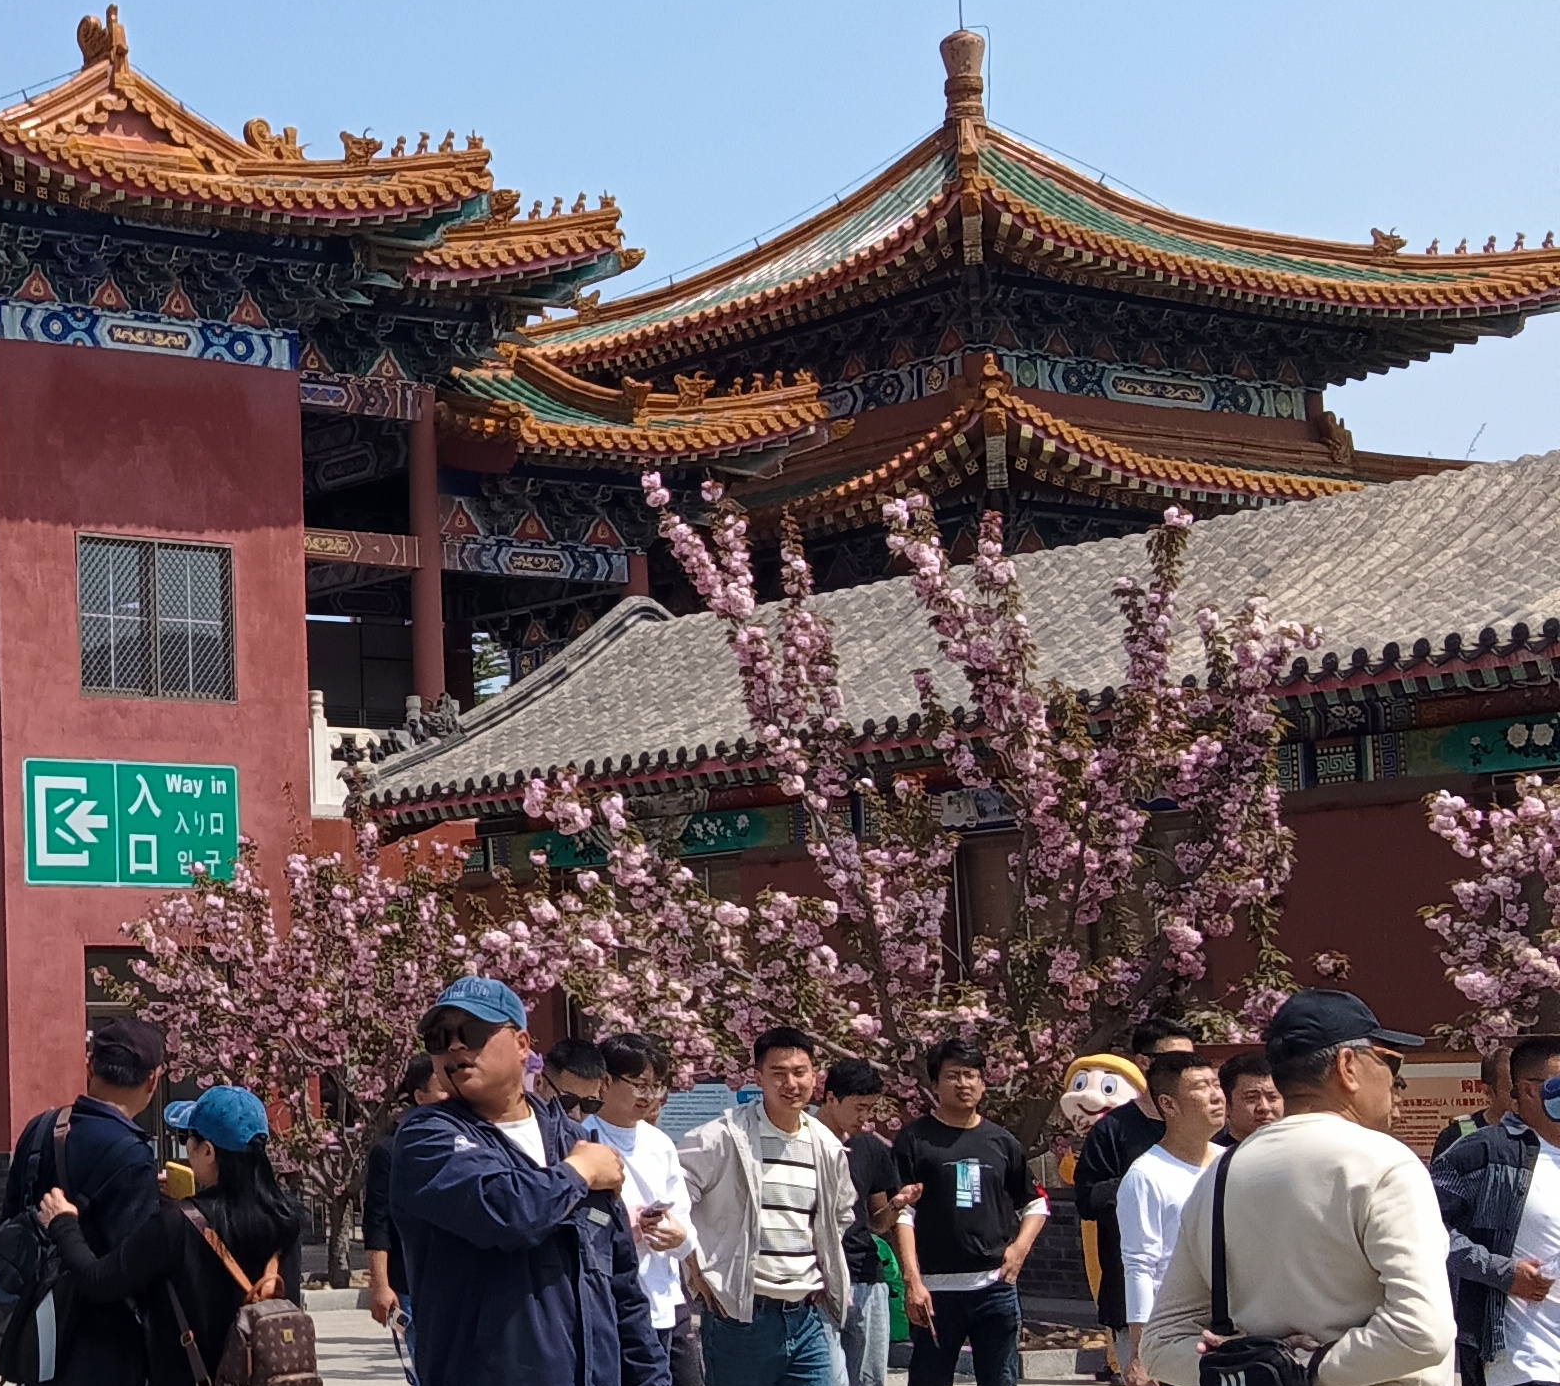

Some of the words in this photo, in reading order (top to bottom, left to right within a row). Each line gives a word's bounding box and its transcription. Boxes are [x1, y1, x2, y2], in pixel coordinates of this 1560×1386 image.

[165, 773, 203, 799] Way
[210, 775, 227, 795] in
[127, 773, 162, 875] 入口
[174, 810, 224, 837] 入り口
